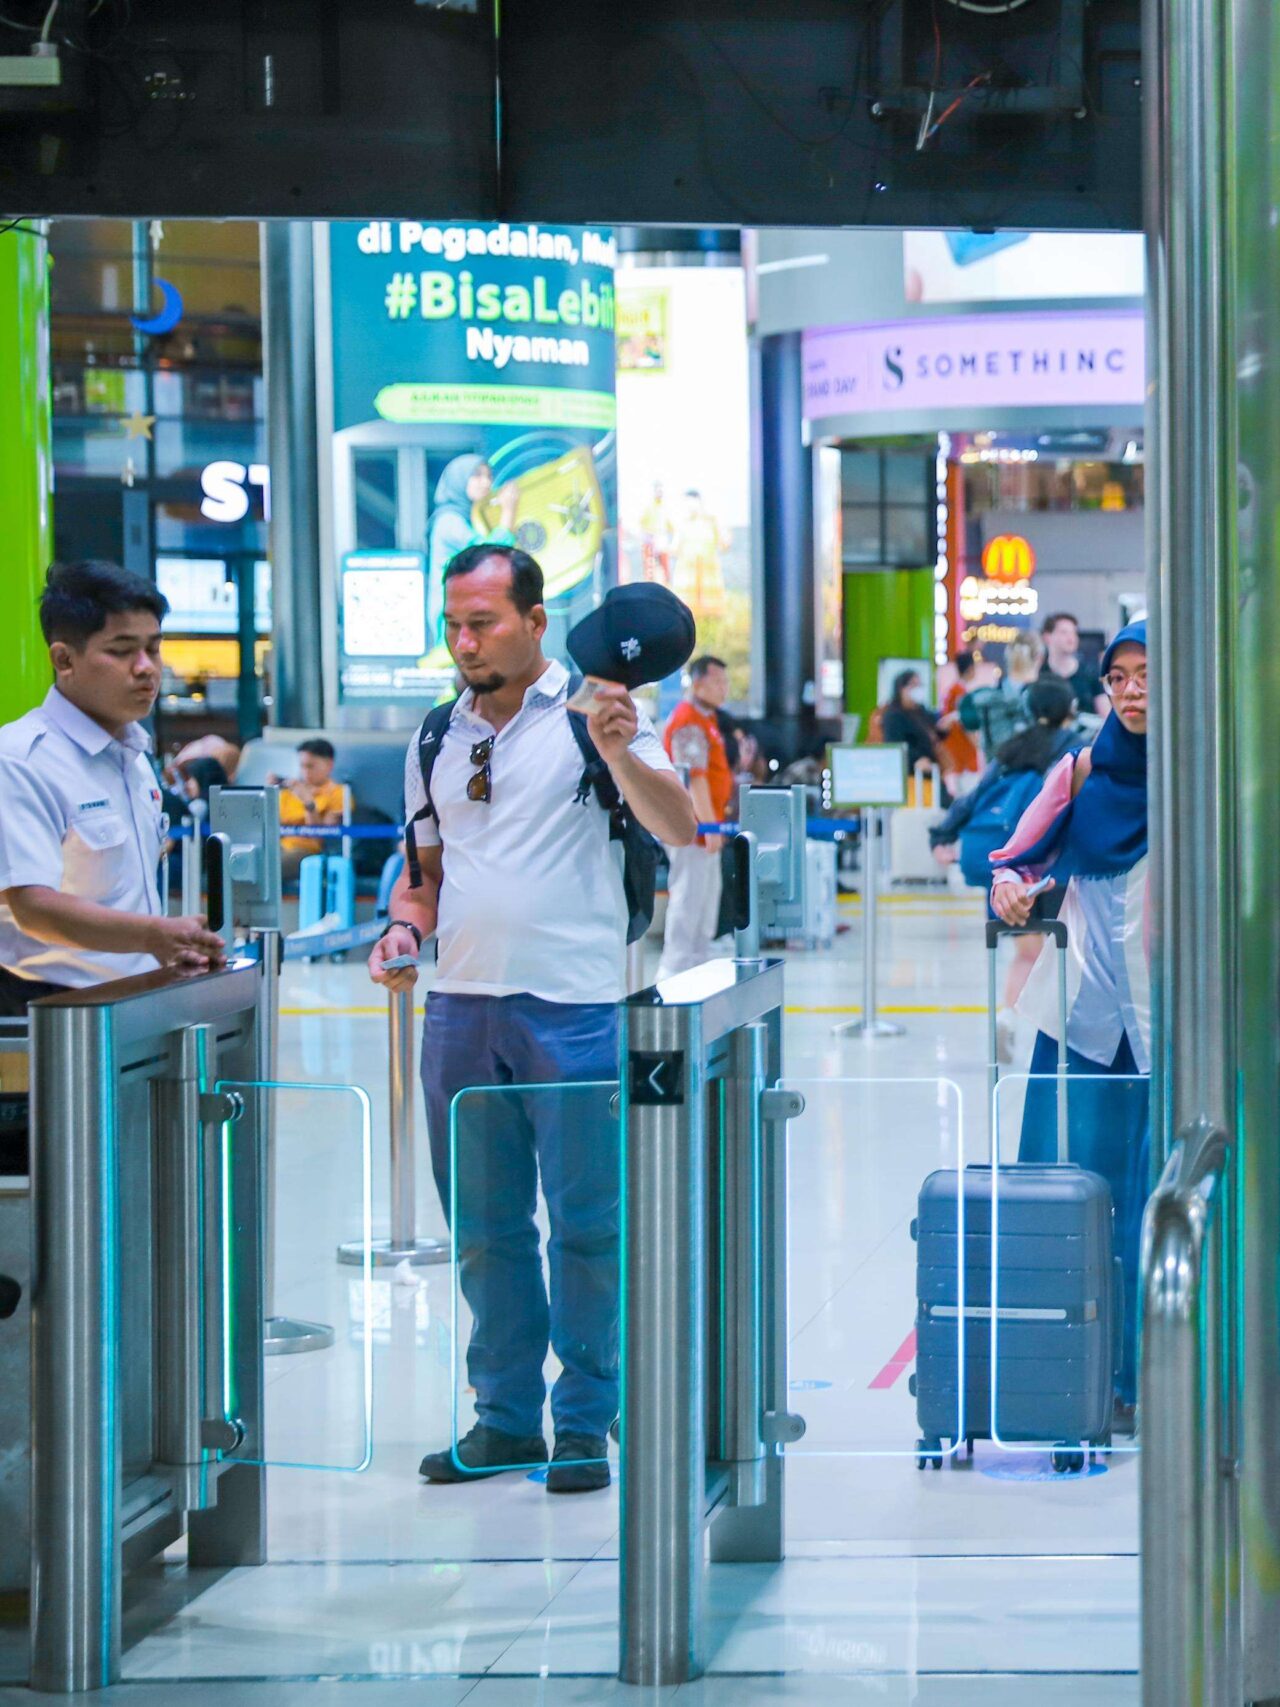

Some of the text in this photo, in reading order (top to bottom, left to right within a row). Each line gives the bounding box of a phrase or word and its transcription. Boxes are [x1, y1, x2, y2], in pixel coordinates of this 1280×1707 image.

[357, 223, 392, 254] di
[400, 223, 579, 267] Pegadaian,
[466, 327, 590, 368] Nyaman
[916, 349, 1126, 378] SOMETHINC
